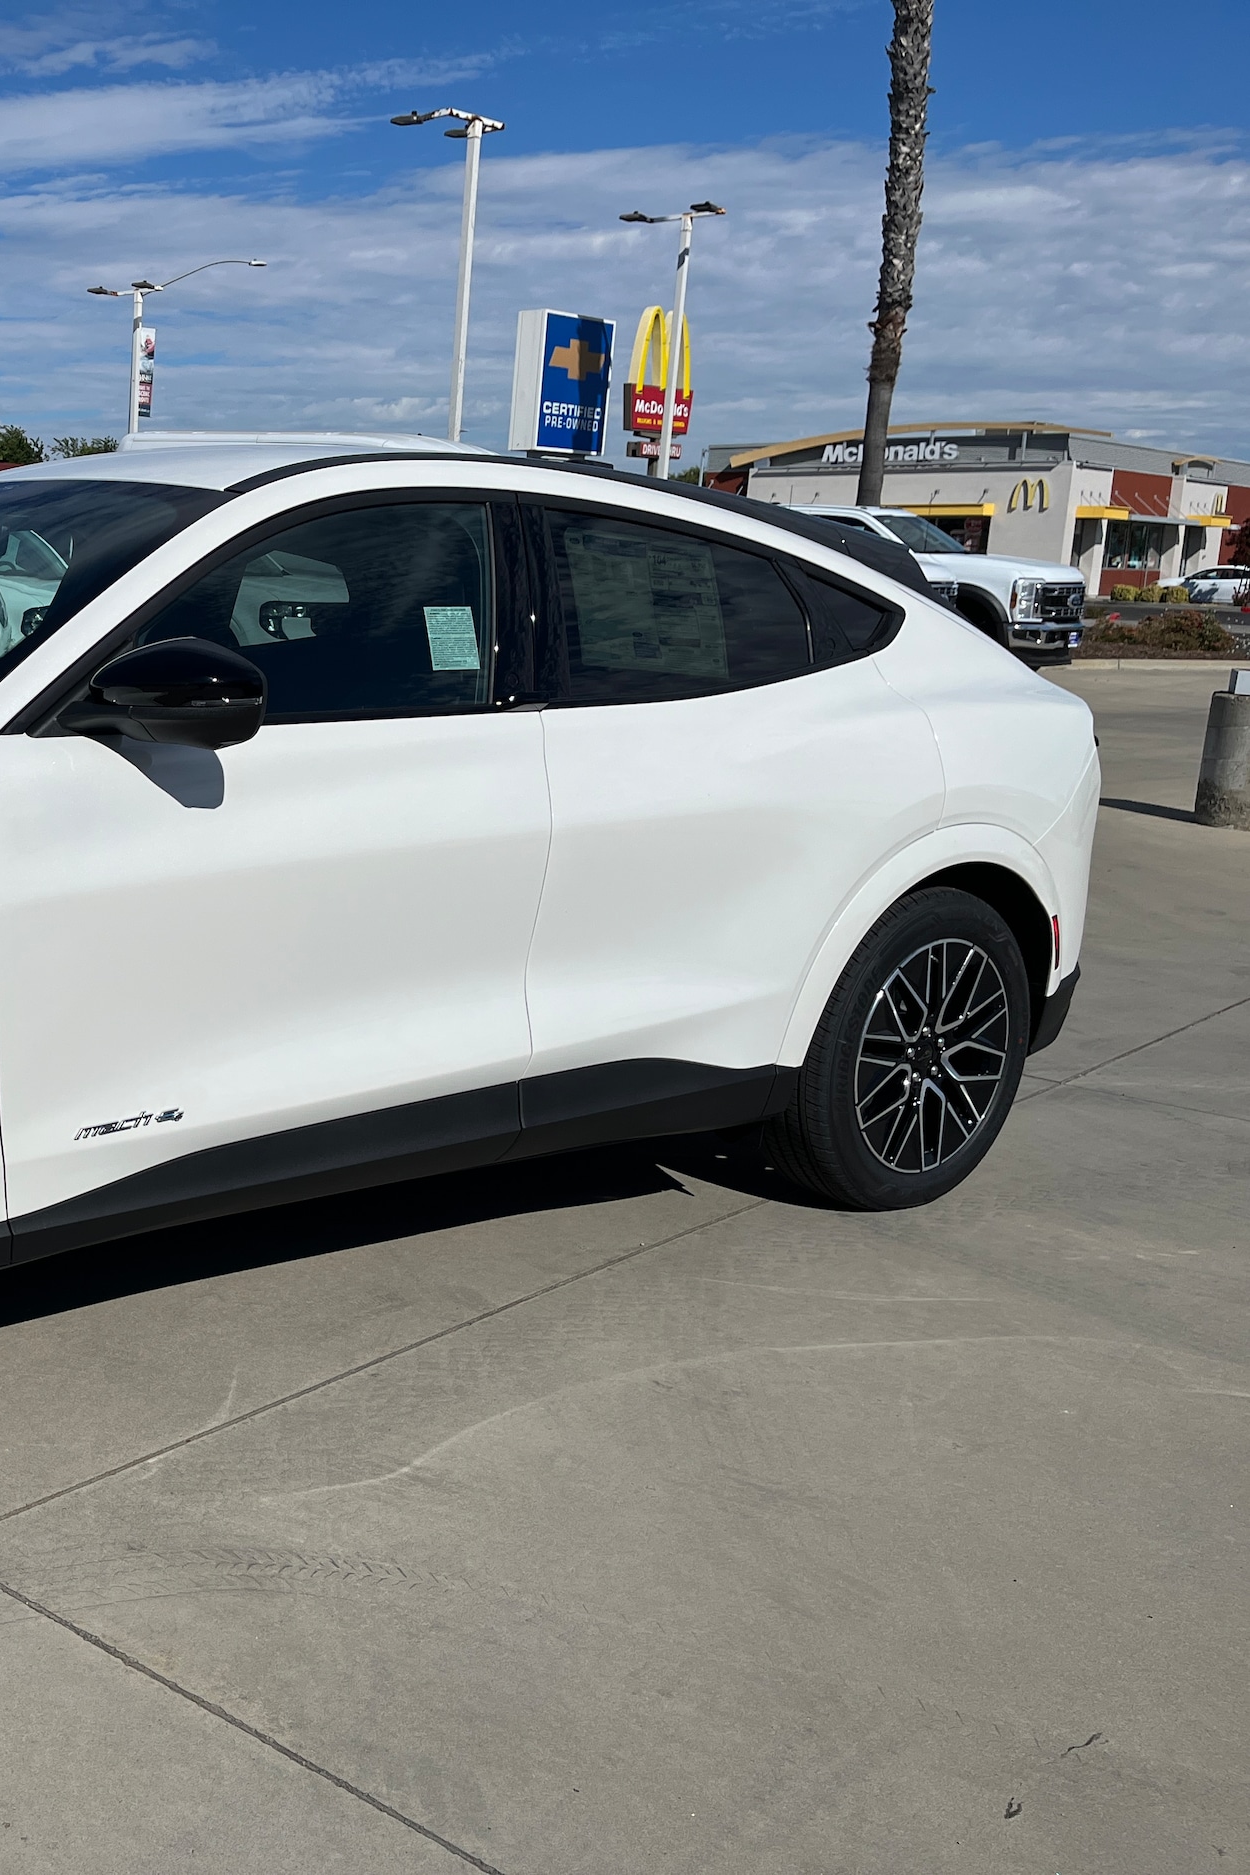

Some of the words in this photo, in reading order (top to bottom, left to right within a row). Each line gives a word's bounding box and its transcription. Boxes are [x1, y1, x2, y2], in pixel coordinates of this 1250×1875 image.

[543, 401, 601, 419] CERTIFIED
[635, 399, 689, 417] McDold's
[545, 415, 598, 432] PRE-OWNED
